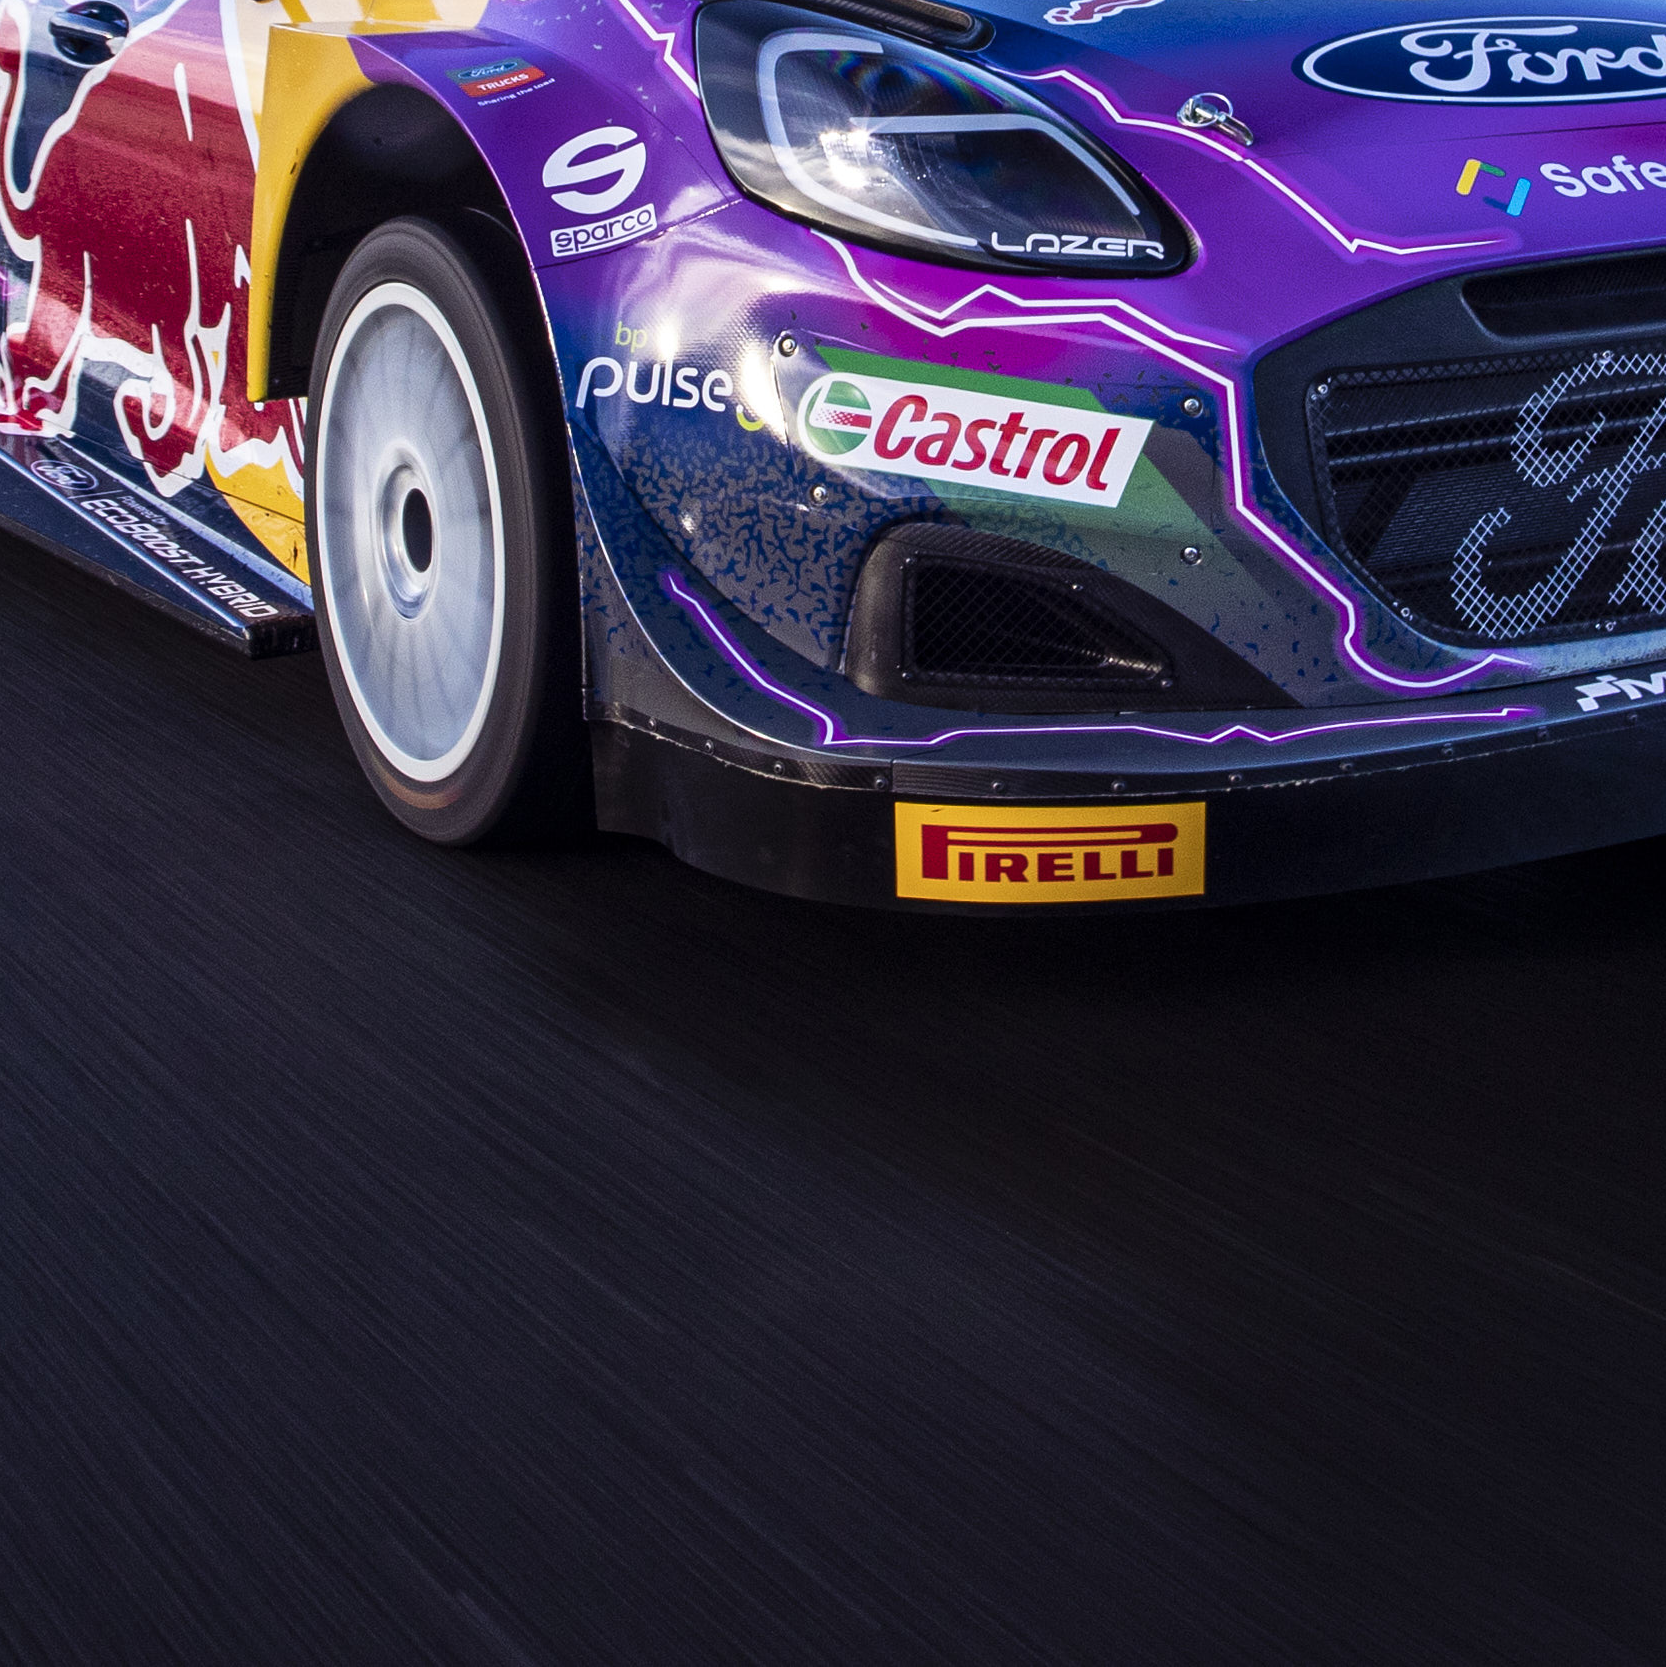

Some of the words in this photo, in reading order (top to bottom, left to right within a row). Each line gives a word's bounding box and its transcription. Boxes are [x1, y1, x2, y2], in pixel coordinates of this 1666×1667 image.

[477, 73, 529, 91] TRUCKS
[516, 87, 533, 96] the
[554, 209, 652, 252] sparco
[991, 231, 1165, 260] LAZER
[615, 321, 648, 353] bp
[575, 355, 733, 413] pulse
[873, 394, 1122, 492] Castrol
[81, 498, 206, 573] ECOBOOST
[183, 565, 279, 618] HYBRID
[921, 823, 1179, 883] PIRELLI
